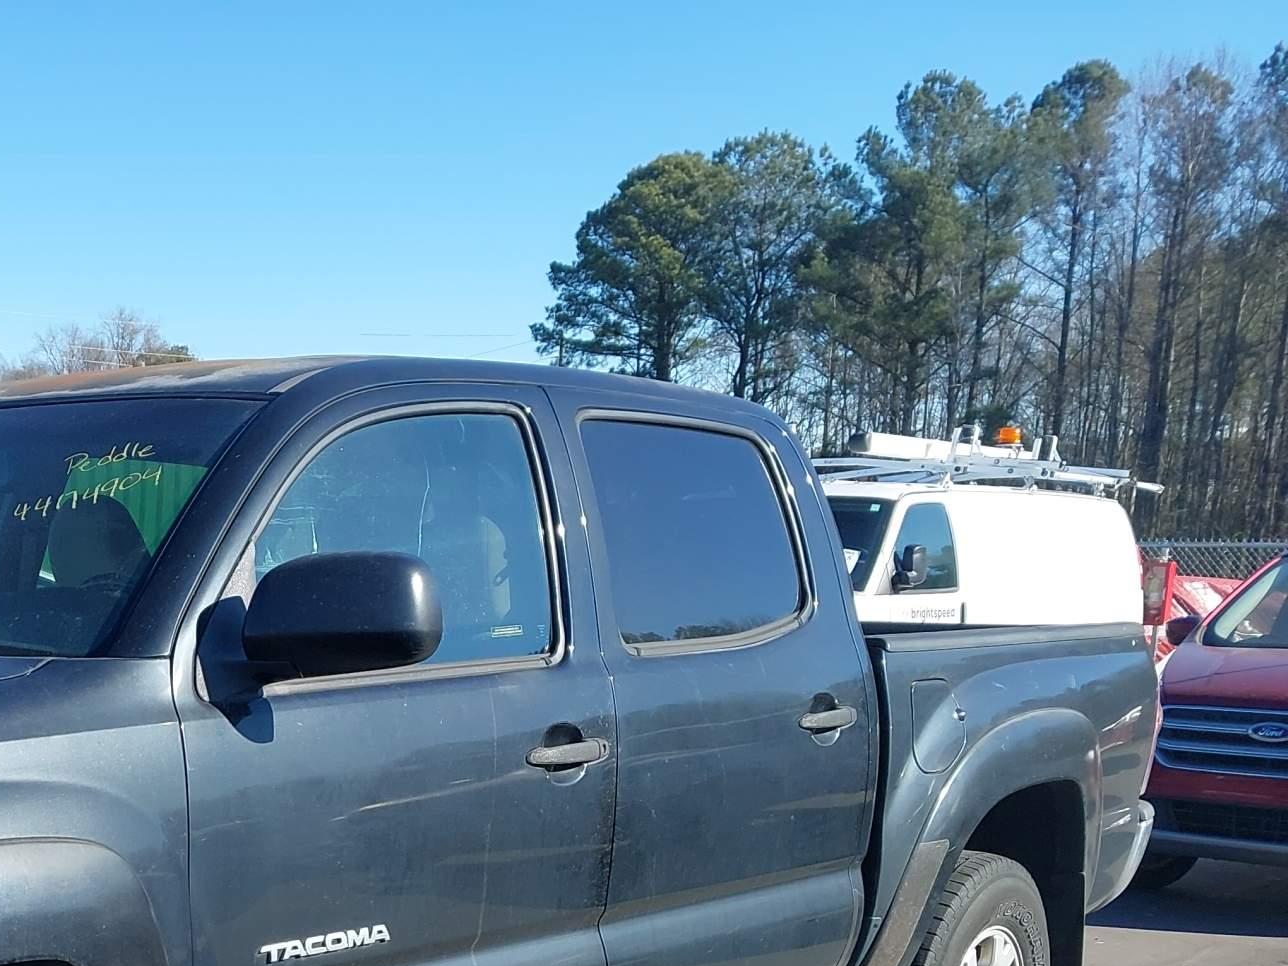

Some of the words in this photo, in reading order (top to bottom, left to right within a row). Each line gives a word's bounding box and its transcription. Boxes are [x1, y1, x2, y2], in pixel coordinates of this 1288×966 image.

[64, 442, 156, 474] Peddle
[14, 465, 162, 521] 44174904
[910, 606, 955, 624] brightspeed
[258, 923, 391, 963] TACOMA
